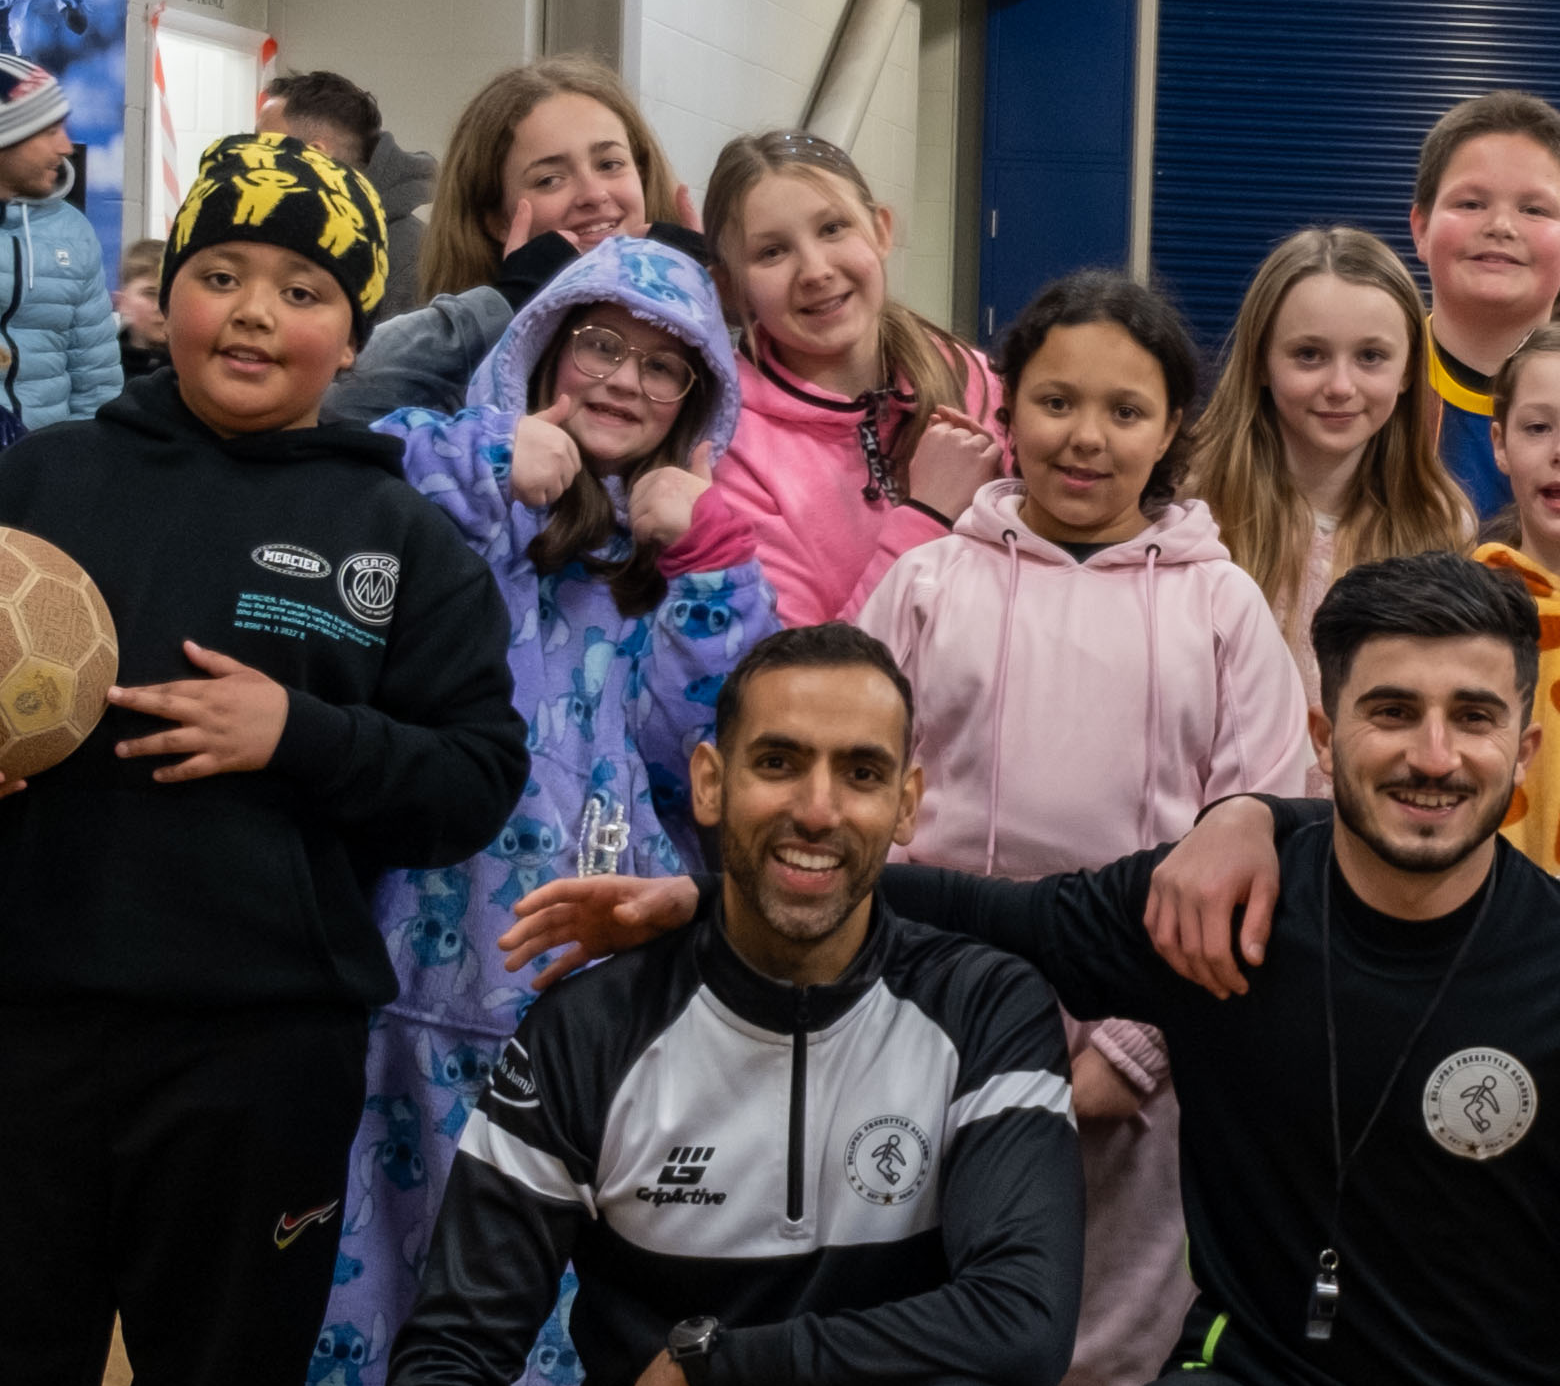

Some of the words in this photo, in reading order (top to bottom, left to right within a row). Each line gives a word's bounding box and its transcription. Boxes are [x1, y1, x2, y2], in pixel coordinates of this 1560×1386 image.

[263, 550, 321, 573] MERCIER
[1455, 1054, 1510, 1070] FREESTYLE
[636, 1186, 727, 1208] GripActive
